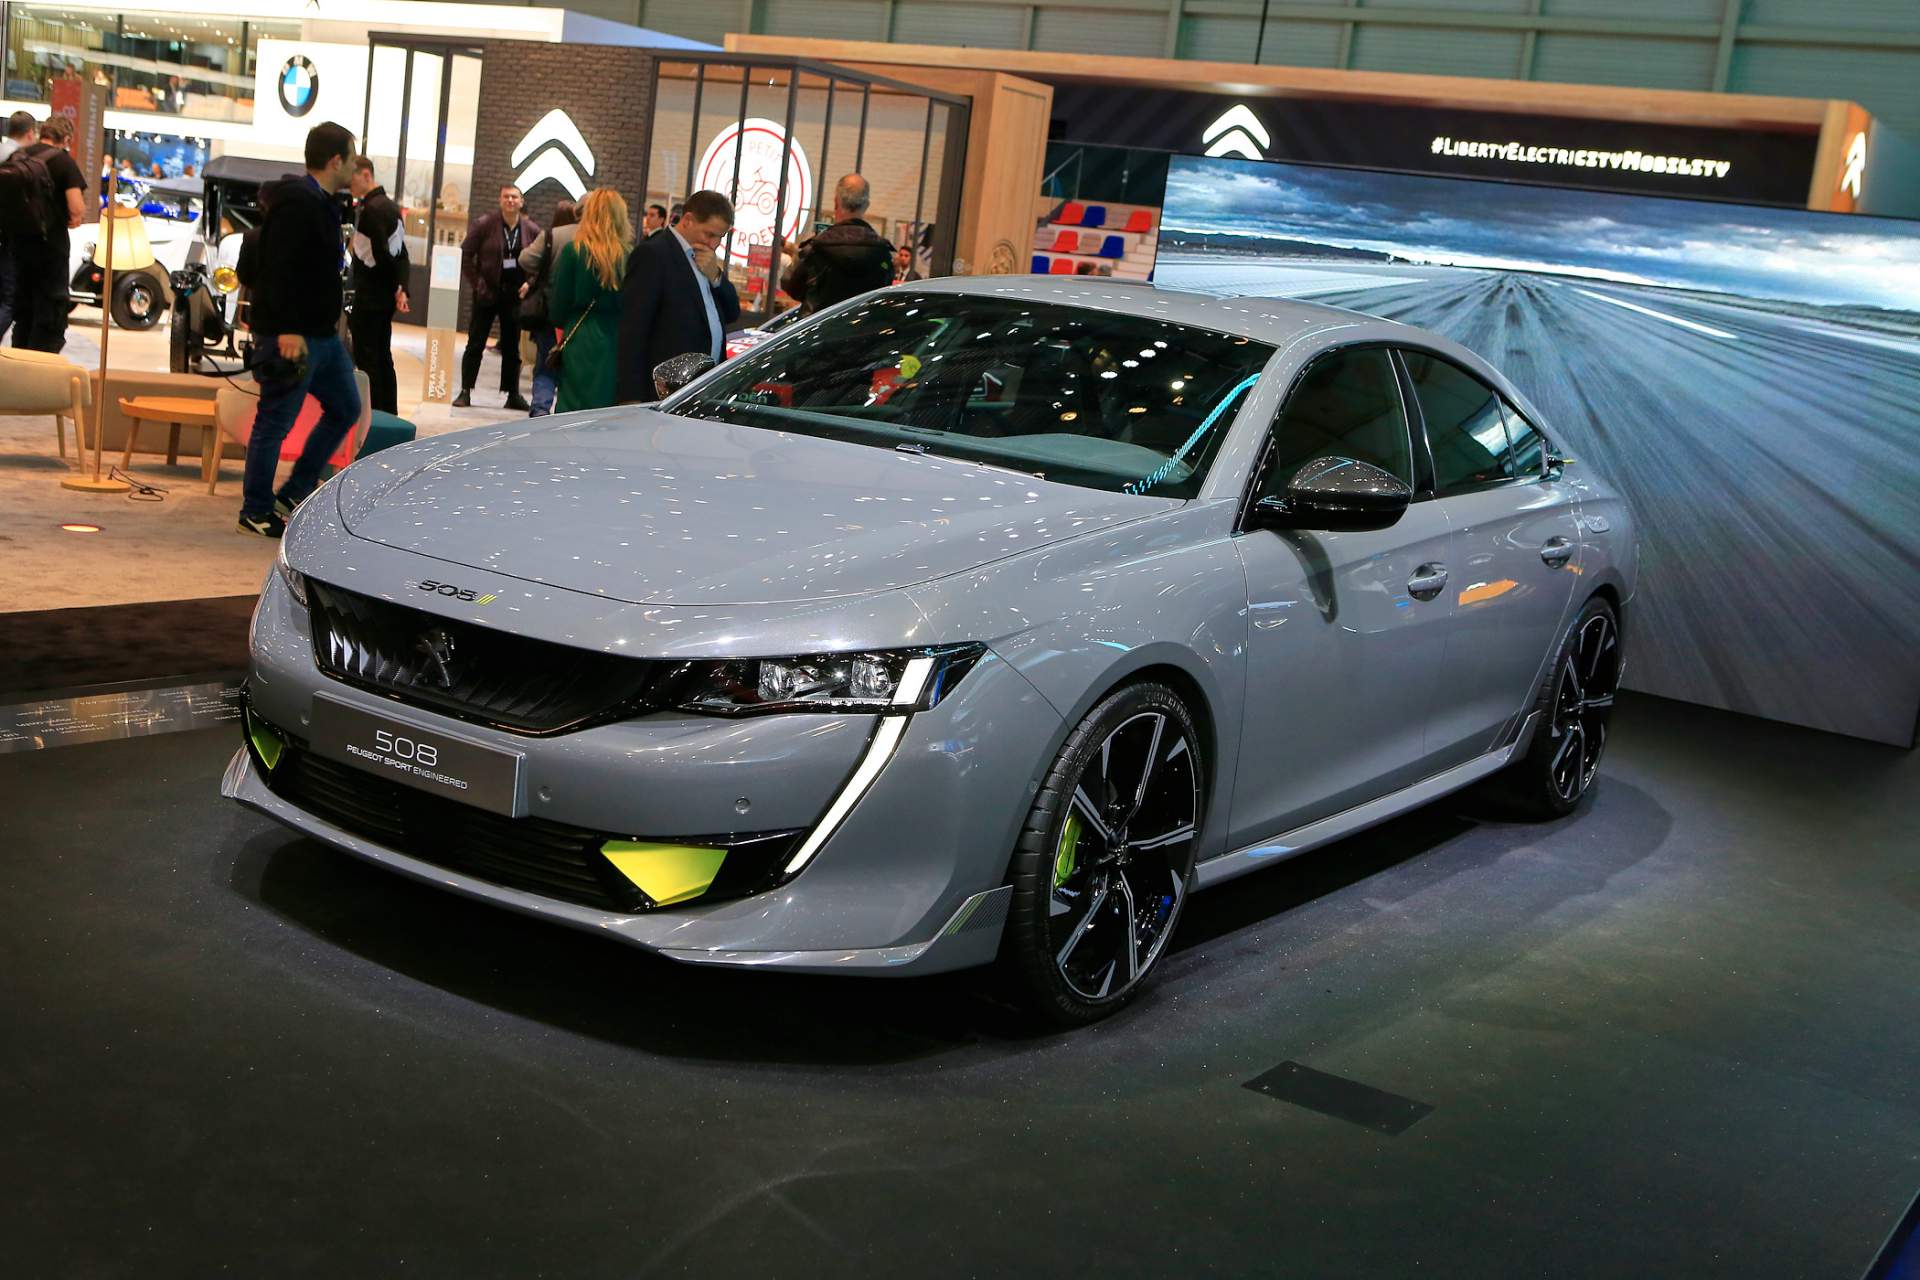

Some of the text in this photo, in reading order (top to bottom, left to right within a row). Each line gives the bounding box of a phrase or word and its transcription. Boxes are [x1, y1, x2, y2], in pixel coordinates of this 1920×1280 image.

[418, 580, 478, 601] 508
[346, 743, 468, 789] PEUGEOT SPORT ENGINEERED
[375, 730, 438, 766] 508
